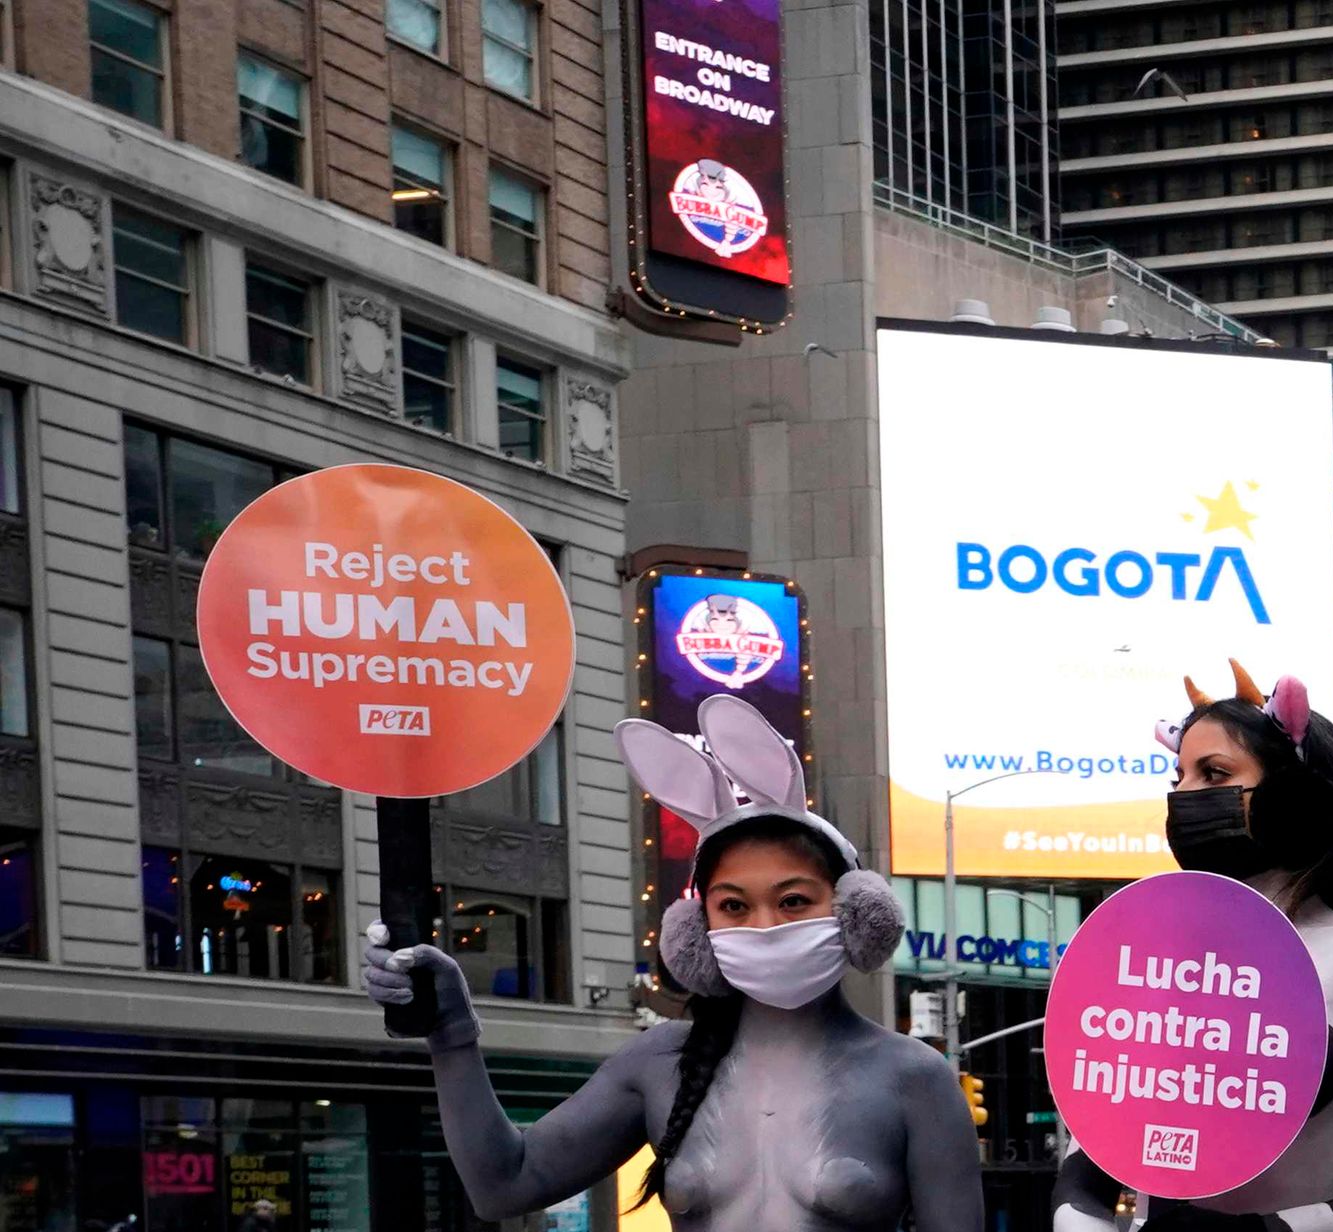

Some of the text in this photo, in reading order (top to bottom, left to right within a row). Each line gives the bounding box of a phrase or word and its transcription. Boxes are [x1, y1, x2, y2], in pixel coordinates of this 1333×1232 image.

[655, 31, 770, 82] ENTRANCE
[697, 67, 731, 92] ON
[654, 75, 775, 125] BROADWAY
[304, 541, 470, 588] Reject
[248, 589, 527, 648] HUMAN
[247, 641, 534, 697] Supremacy
[944, 750, 1179, 779] www.BogotaD
[1117, 945, 1261, 999] Lucha
[1080, 1005, 1289, 1058] contra la
[1072, 1049, 1287, 1114] injusticia
[1146, 1150, 1192, 1166] LATINO
